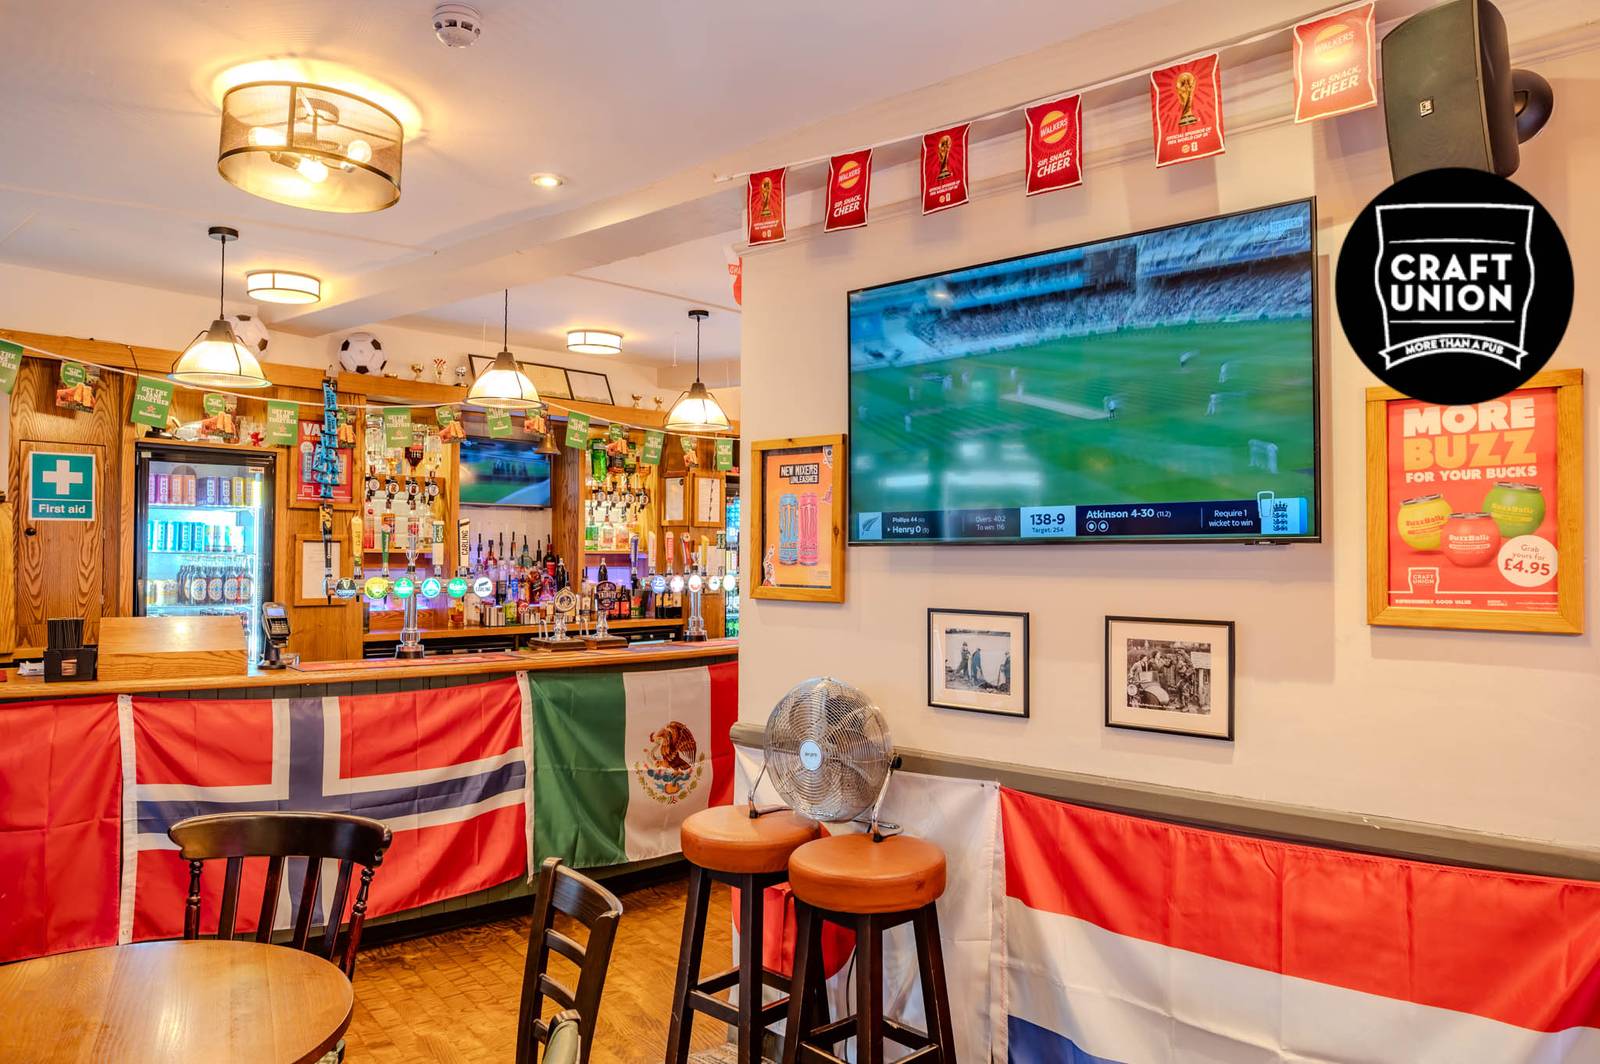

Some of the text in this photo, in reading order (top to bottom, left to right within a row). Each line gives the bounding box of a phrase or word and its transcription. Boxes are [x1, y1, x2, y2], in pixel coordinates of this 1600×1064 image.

[1311, 75, 1360, 102] CHEER
[1040, 117, 1068, 137] WALKERS
[839, 167, 862, 182] WALKERS
[1037, 157, 1071, 178] CHEER
[833, 201, 860, 218] CHEER
[1403, 398, 1536, 437] MORE
[1403, 429, 1537, 471] BUZZ
[1405, 465, 1537, 484] FOR YOUR BUCKS
[39, 504, 86, 514] First aid
[1086, 509, 1129, 519] Atkinson
[1131, 508, 1155, 518] 4-30
[1214, 509, 1243, 518] Require
[1030, 513, 1066, 526] 138-9
[1208, 519, 1231, 527] wicket
[1232, 519, 1240, 527] to
[892, 526, 914, 534] Henry
[461, 530, 469, 556] CARLING
[1520, 544, 1540, 553] Grab
[1512, 551, 1546, 561] yours for
[1504, 558, 1551, 577] £4.95
